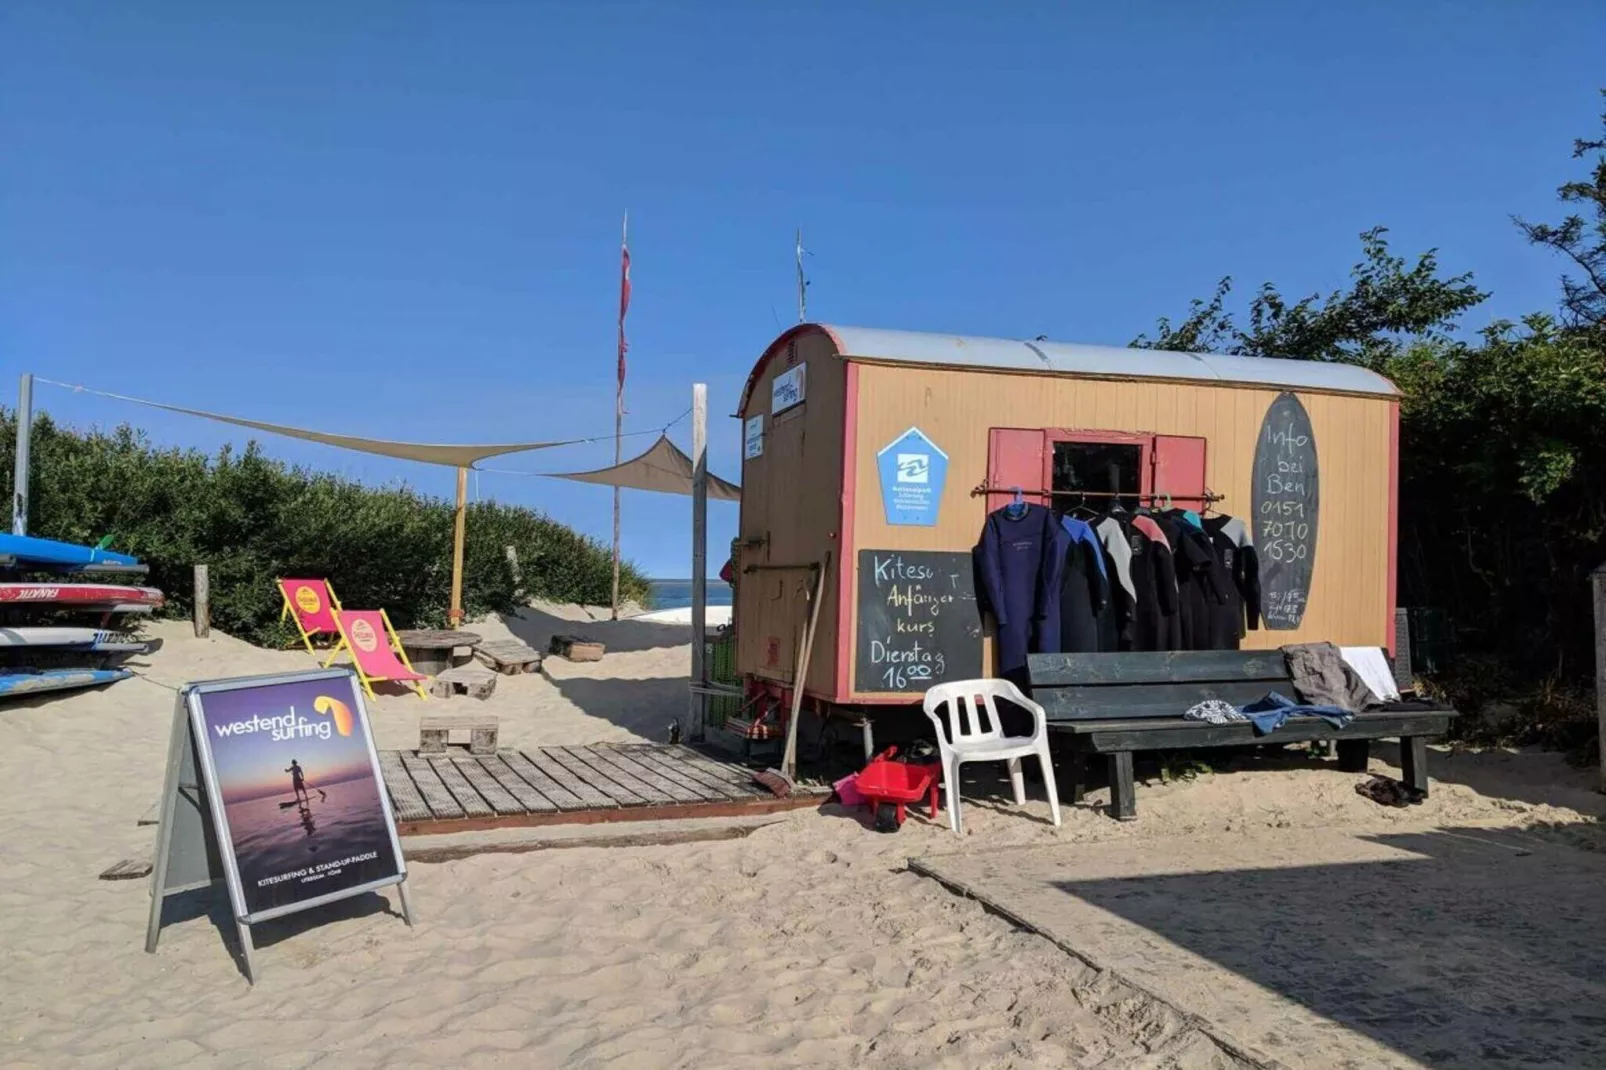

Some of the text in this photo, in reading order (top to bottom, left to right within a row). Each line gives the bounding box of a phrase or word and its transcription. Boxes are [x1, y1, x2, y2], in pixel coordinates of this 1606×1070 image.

[1266, 422, 1308, 455] Info
[1277, 454, 1303, 473] bei
[1266, 473, 1305, 496] Ben
[1261, 500, 1304, 518] 0151
[1263, 539, 1307, 563] 1530
[15, 588, 59, 599] FANATIC
[870, 636, 946, 674] Dienstag
[214, 705, 295, 737] westend
[271, 716, 332, 741] surfing
[257, 868, 307, 888] KITESURFING
[308, 867, 316, 875] &
